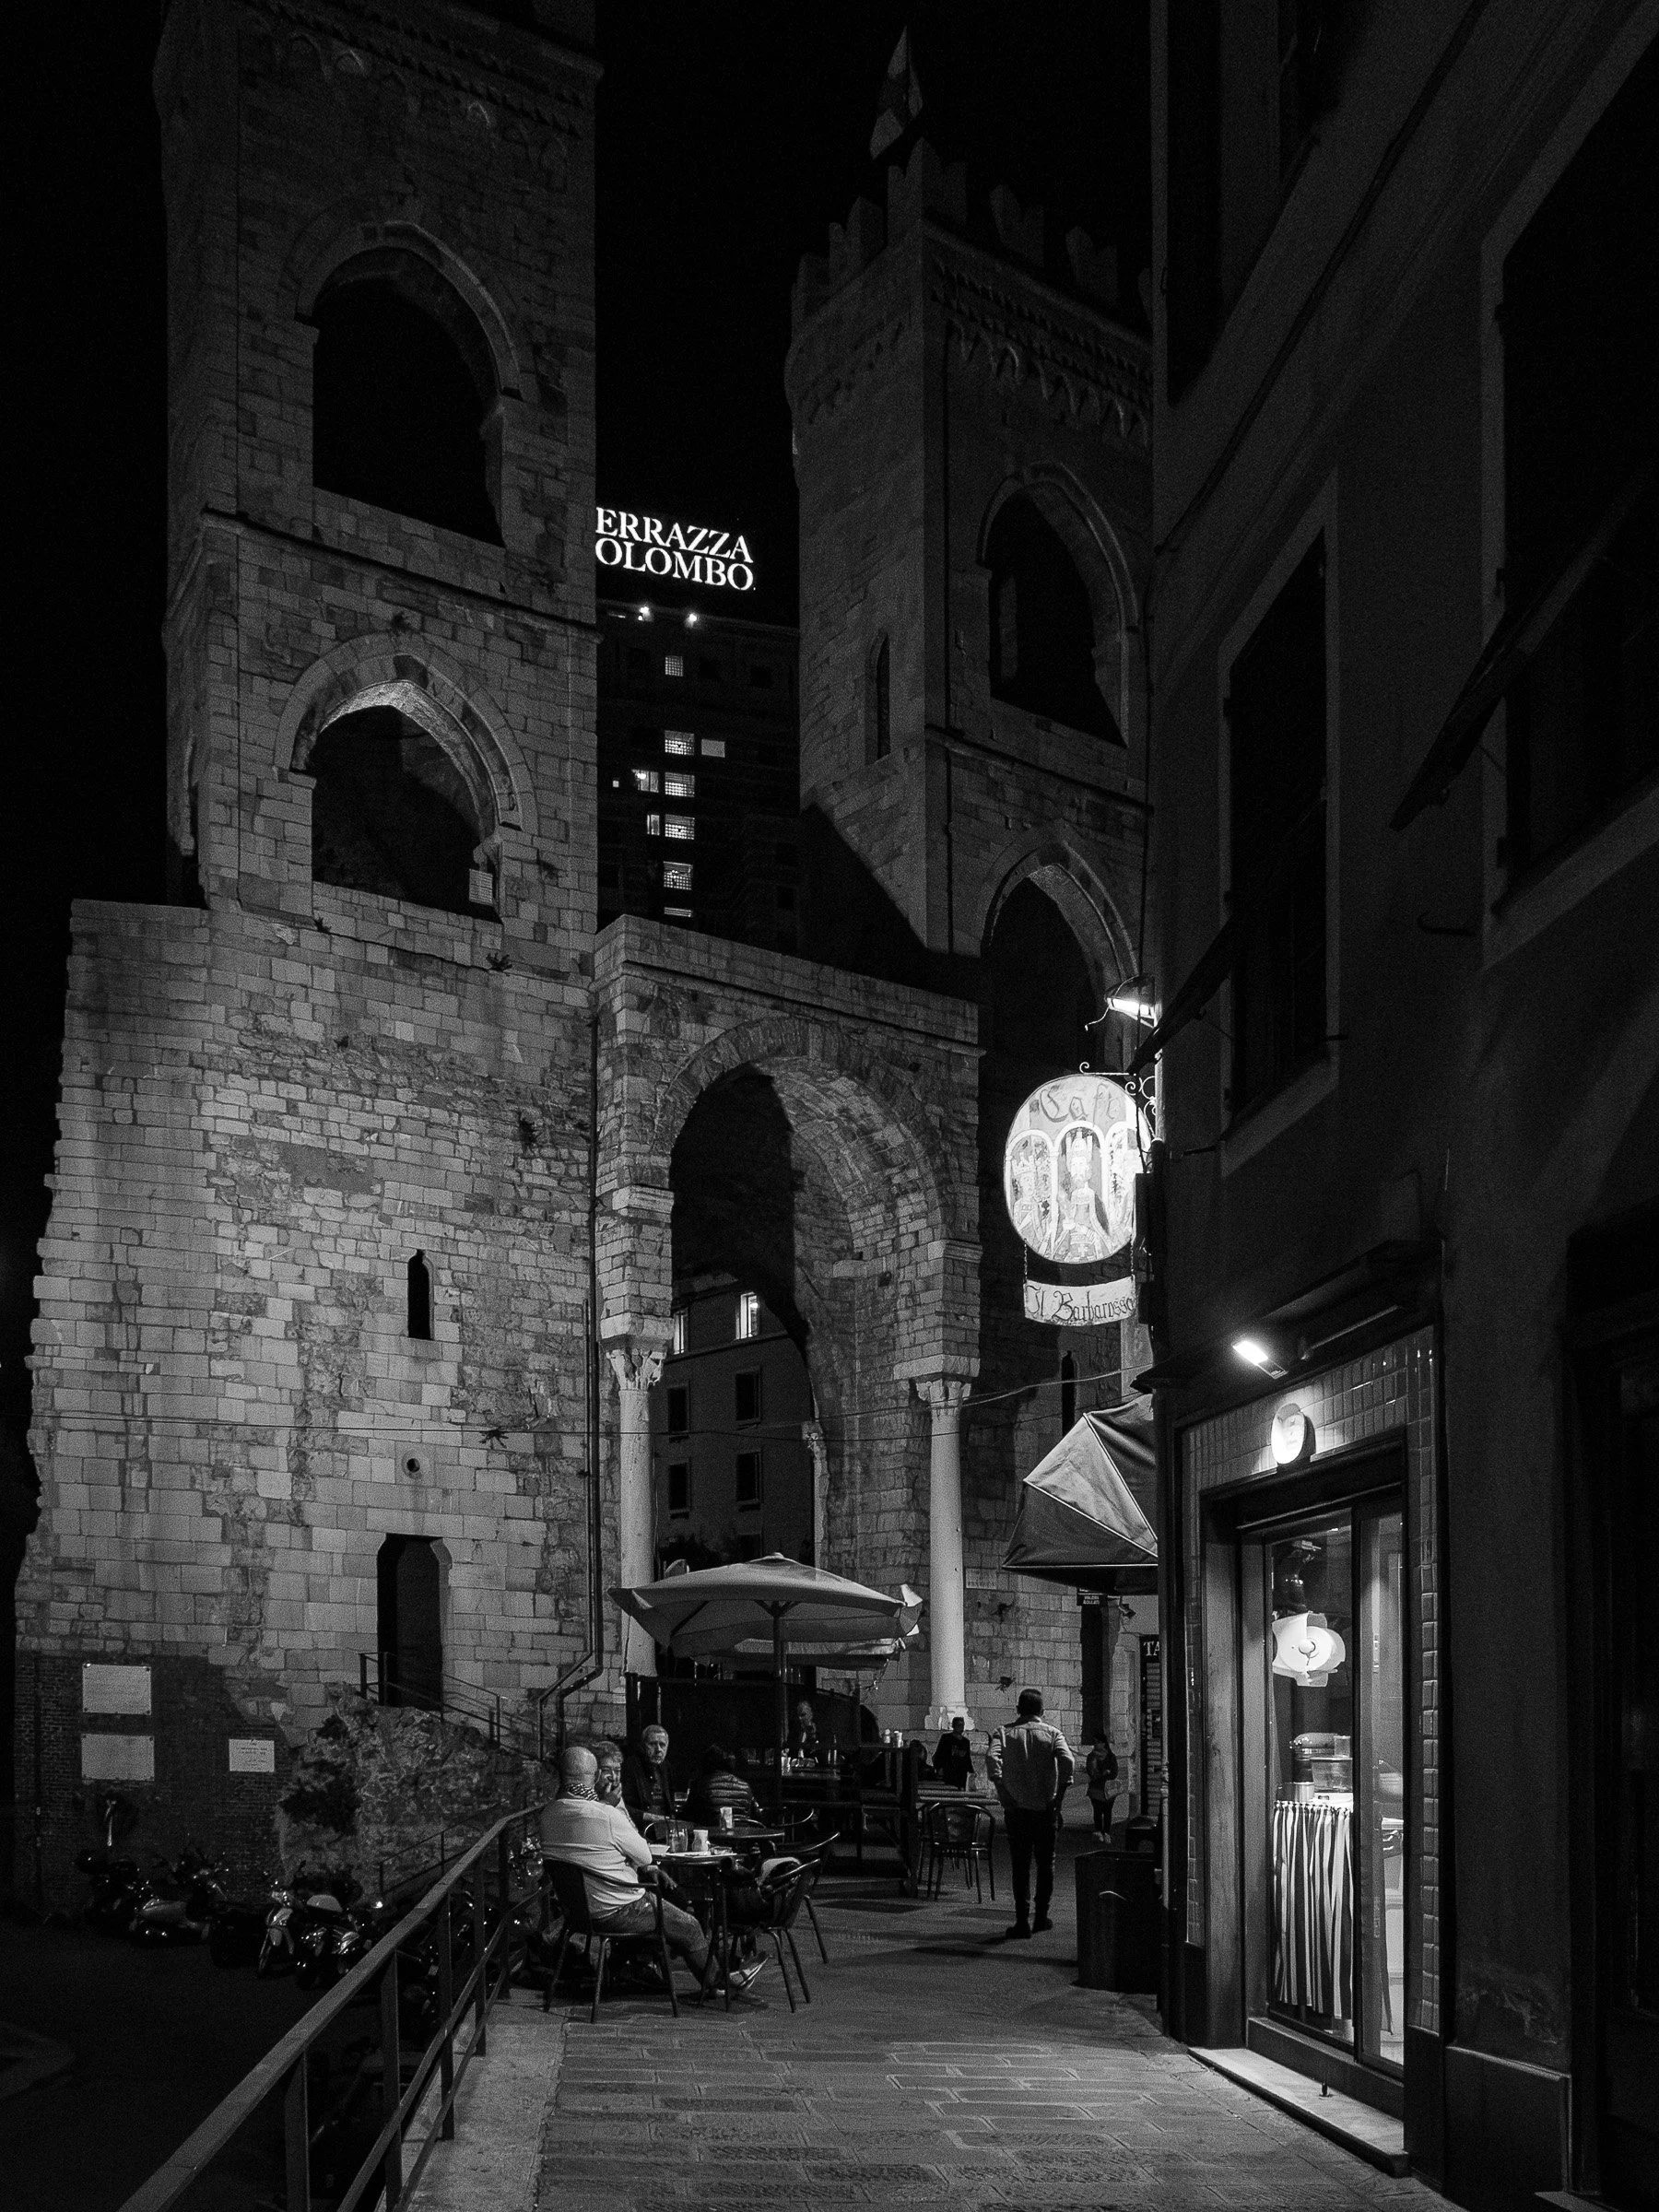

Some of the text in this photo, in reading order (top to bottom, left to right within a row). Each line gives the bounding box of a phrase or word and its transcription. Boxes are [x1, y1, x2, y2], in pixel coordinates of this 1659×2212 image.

[594, 506, 754, 563] ERRAZZA
[1026, 1285, 1135, 1322] Il Barbarossa
